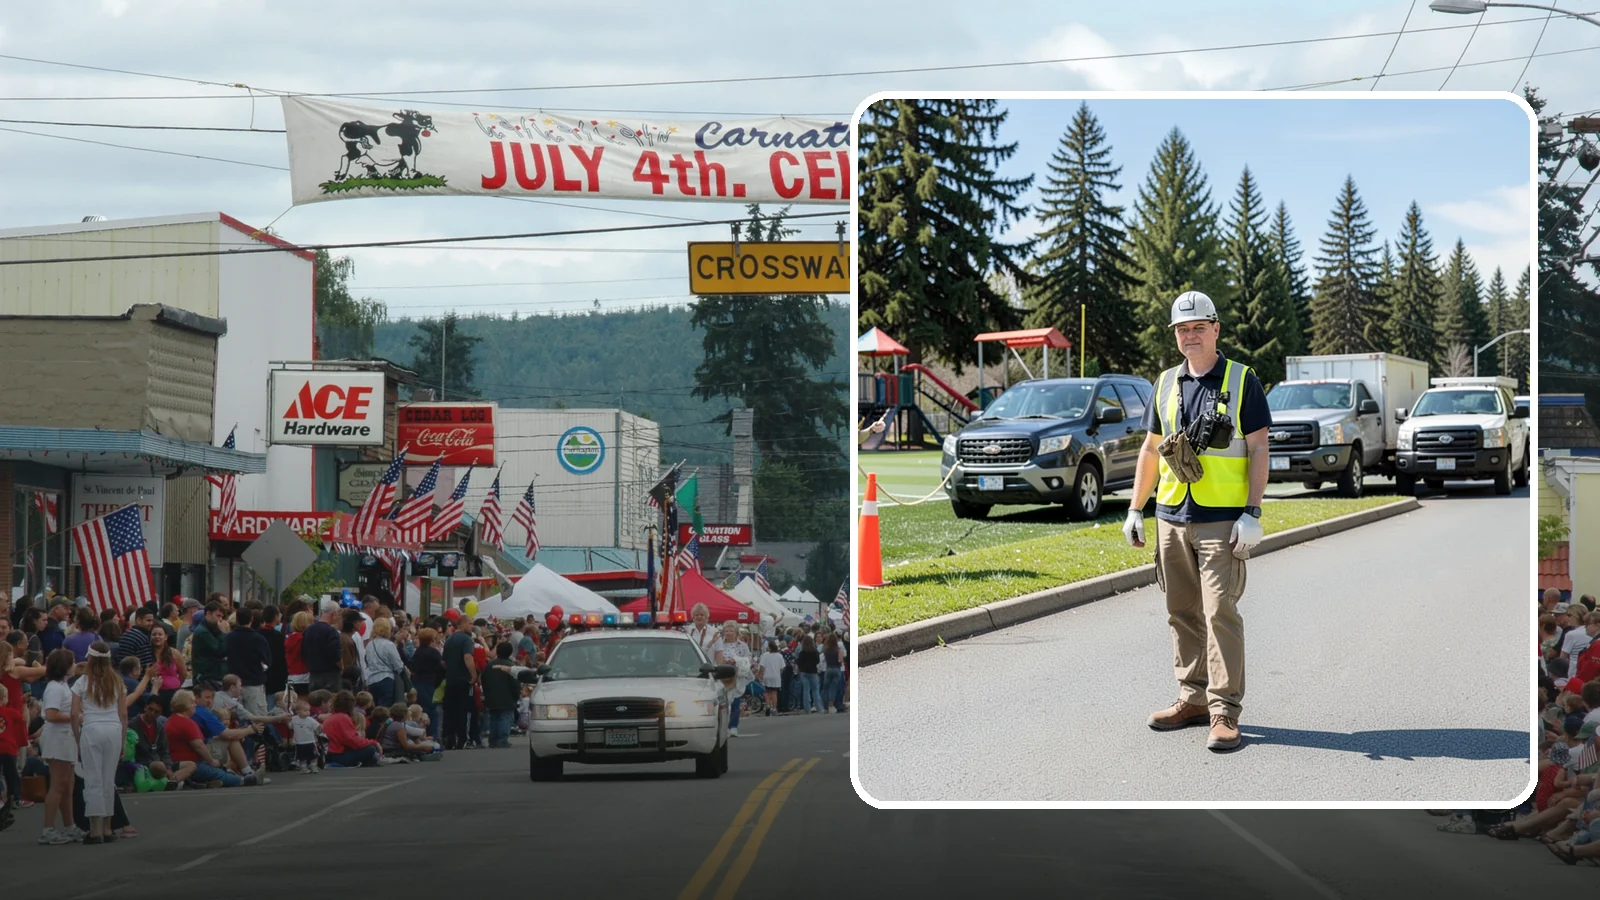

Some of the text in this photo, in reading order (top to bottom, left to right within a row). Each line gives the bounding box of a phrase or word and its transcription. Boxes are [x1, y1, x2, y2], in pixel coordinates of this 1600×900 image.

[481, 141, 604, 192] JULY
[632, 150, 746, 197] 4th.
[697, 254, 850, 280] CROSSWA
[283, 380, 373, 420] ACE
[406, 409, 485, 421] CEDAR LOG
[284, 421, 371, 437] Hardware
[416, 428, 477, 447] Coca-Cola
[95, 485, 124, 494] Vincent
[126, 486, 135, 494] de
[138, 486, 155, 495] Paul
[81, 503, 153, 522] THRT
[688, 526, 741, 535] CRNATION
[699, 535, 730, 543] GLASS
